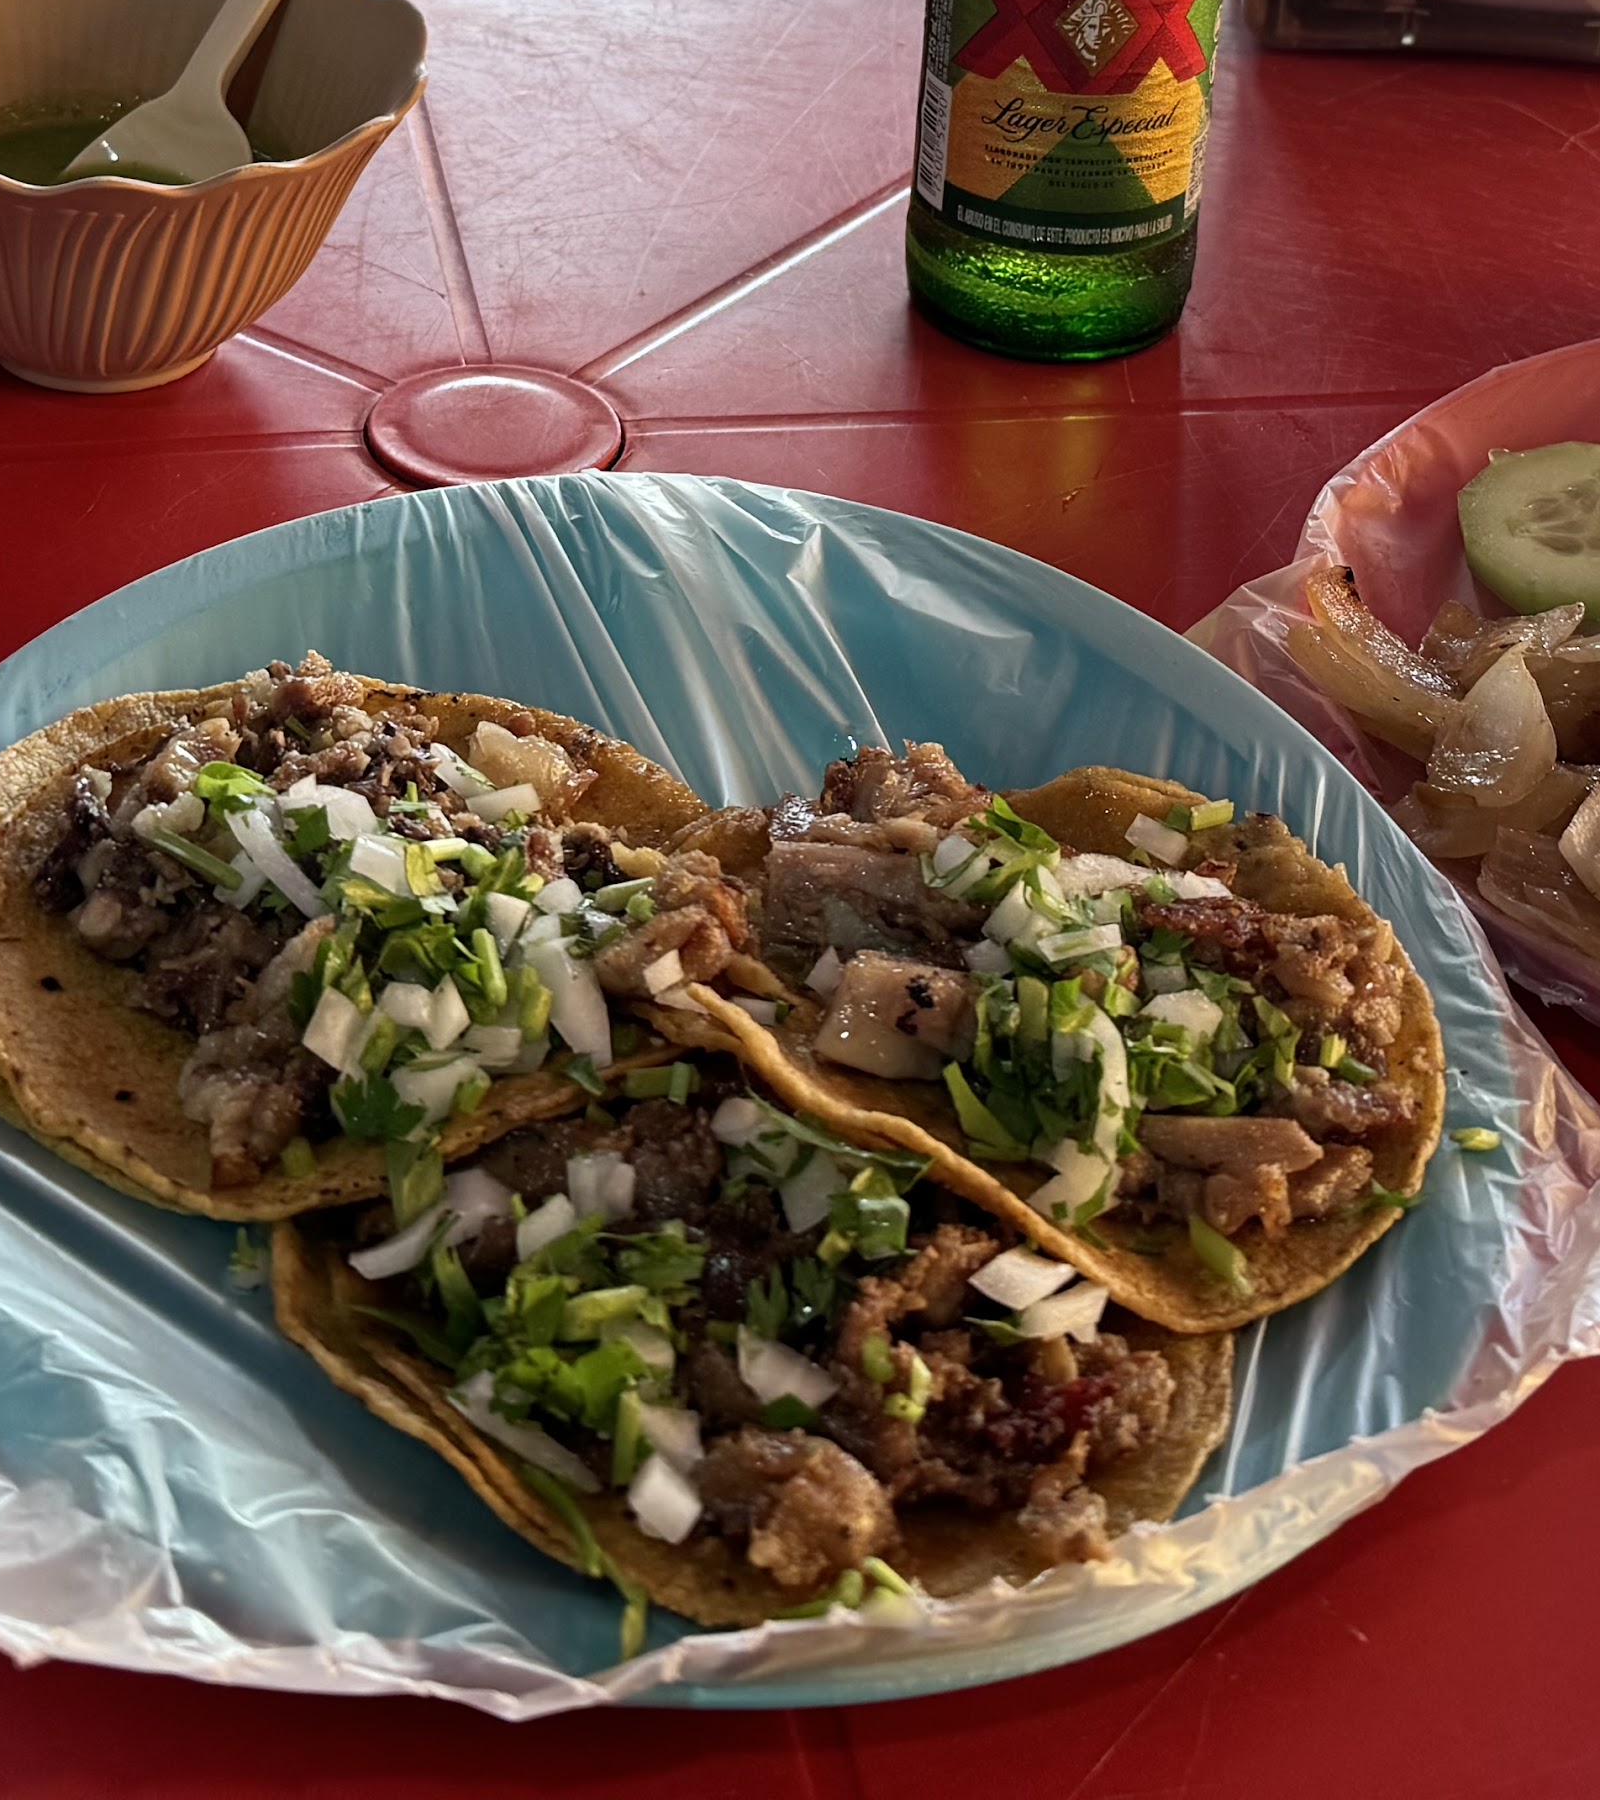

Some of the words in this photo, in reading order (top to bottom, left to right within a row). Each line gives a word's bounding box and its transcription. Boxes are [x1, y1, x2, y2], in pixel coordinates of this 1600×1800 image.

[981, 97, 1070, 143] Lager
[1071, 98, 1181, 145] Especial
[1064, 227, 1101, 246] PRODUCTO
